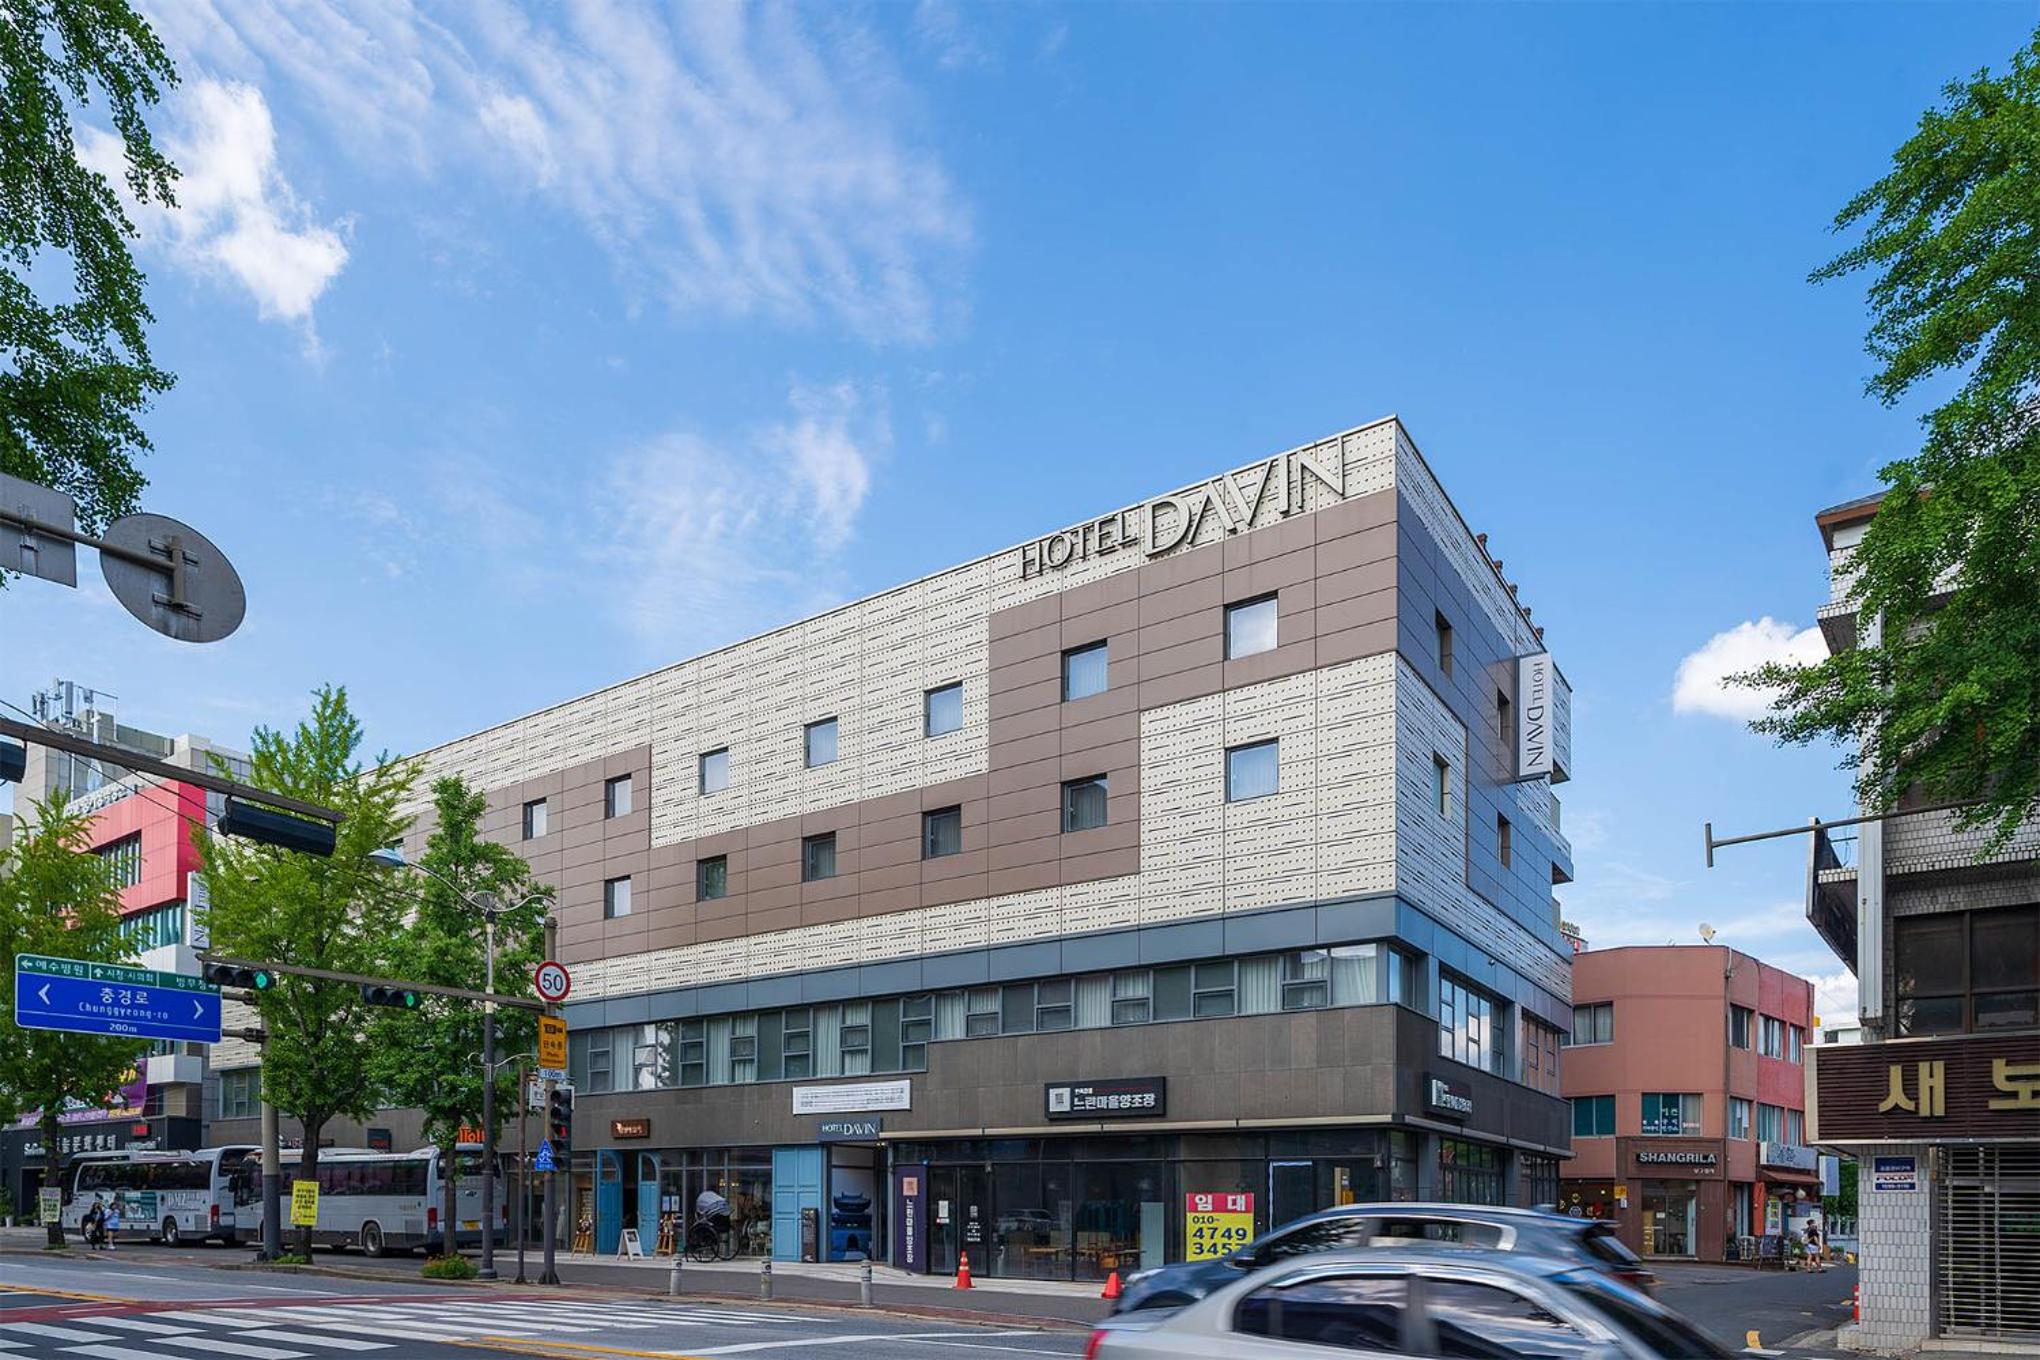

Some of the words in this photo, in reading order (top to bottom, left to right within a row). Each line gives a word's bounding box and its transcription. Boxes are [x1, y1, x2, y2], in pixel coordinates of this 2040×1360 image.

[1018, 512, 1139, 581] HOTEL
[1144, 436, 1347, 558] DAVIN
[1532, 661, 1544, 705] HOTEL
[1527, 705, 1544, 767] DAVIN
[35, 960, 84, 976] 예수병원
[542, 973, 564, 992] 50
[100, 987, 149, 1005] 충경로
[78, 1001, 169, 1020] Chunggyeong-ro
[109, 1022, 138, 1034] 200m
[1073, 1093, 1156, 1111] 느린마을양조장
[822, 1123, 844, 1133] HOTEL
[843, 1122, 876, 1136] DAVIN
[1639, 1152, 1717, 1164] SHANGRILA
[1192, 1226, 1248, 1241] 4749
